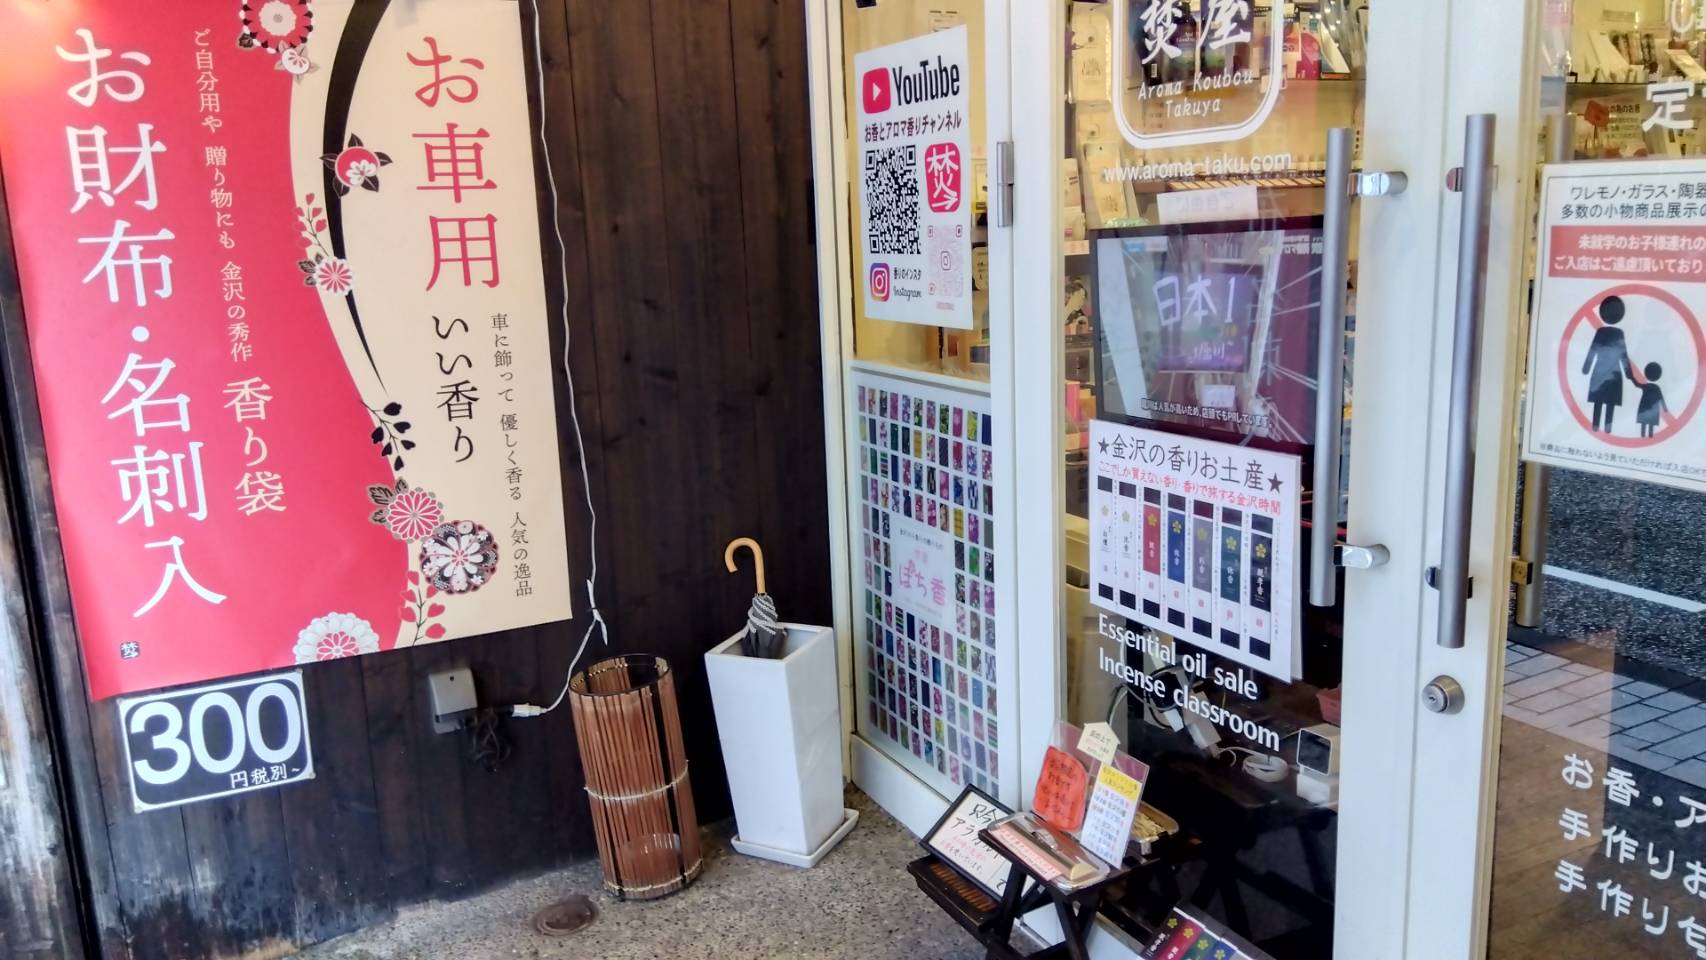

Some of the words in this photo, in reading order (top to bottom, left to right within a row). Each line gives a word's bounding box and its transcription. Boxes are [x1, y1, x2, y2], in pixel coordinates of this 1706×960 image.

[193, 29, 223, 134] ご自分用や
[892, 55, 960, 107] YouTube
[1137, 82, 1184, 102] Aroma
[1193, 68, 1254, 93] Koubou
[1165, 97, 1222, 119] Takuya
[1642, 75, 1706, 132] 定
[406, 36, 501, 292] お車用
[864, 111, 962, 142] お香とアロマ香りチャンネル
[1104, 152, 1293, 183] www.aroma-taku.com
[204, 146, 236, 250] 贈り物にも
[1577, 234, 1705, 251] 未就学のお子様連れの
[55, 28, 226, 617] お財布・名刺入
[220, 261, 253, 362] 金沢の秀作
[893, 286, 923, 303] Instagram
[430, 315, 480, 464] いい香り
[491, 314, 514, 402] 車に飾って
[223, 377, 286, 516] 香り袋
[500, 413, 523, 501] 優しく香る
[510, 512, 532, 596] 人気の逸品
[1099, 613, 1176, 666] Essential
[1182, 653, 1207, 679] oil
[1214, 666, 1258, 701] sale
[1099, 647, 1166, 698] Incense
[1173, 686, 1280, 753] classroom
[129, 683, 303, 786] 300
